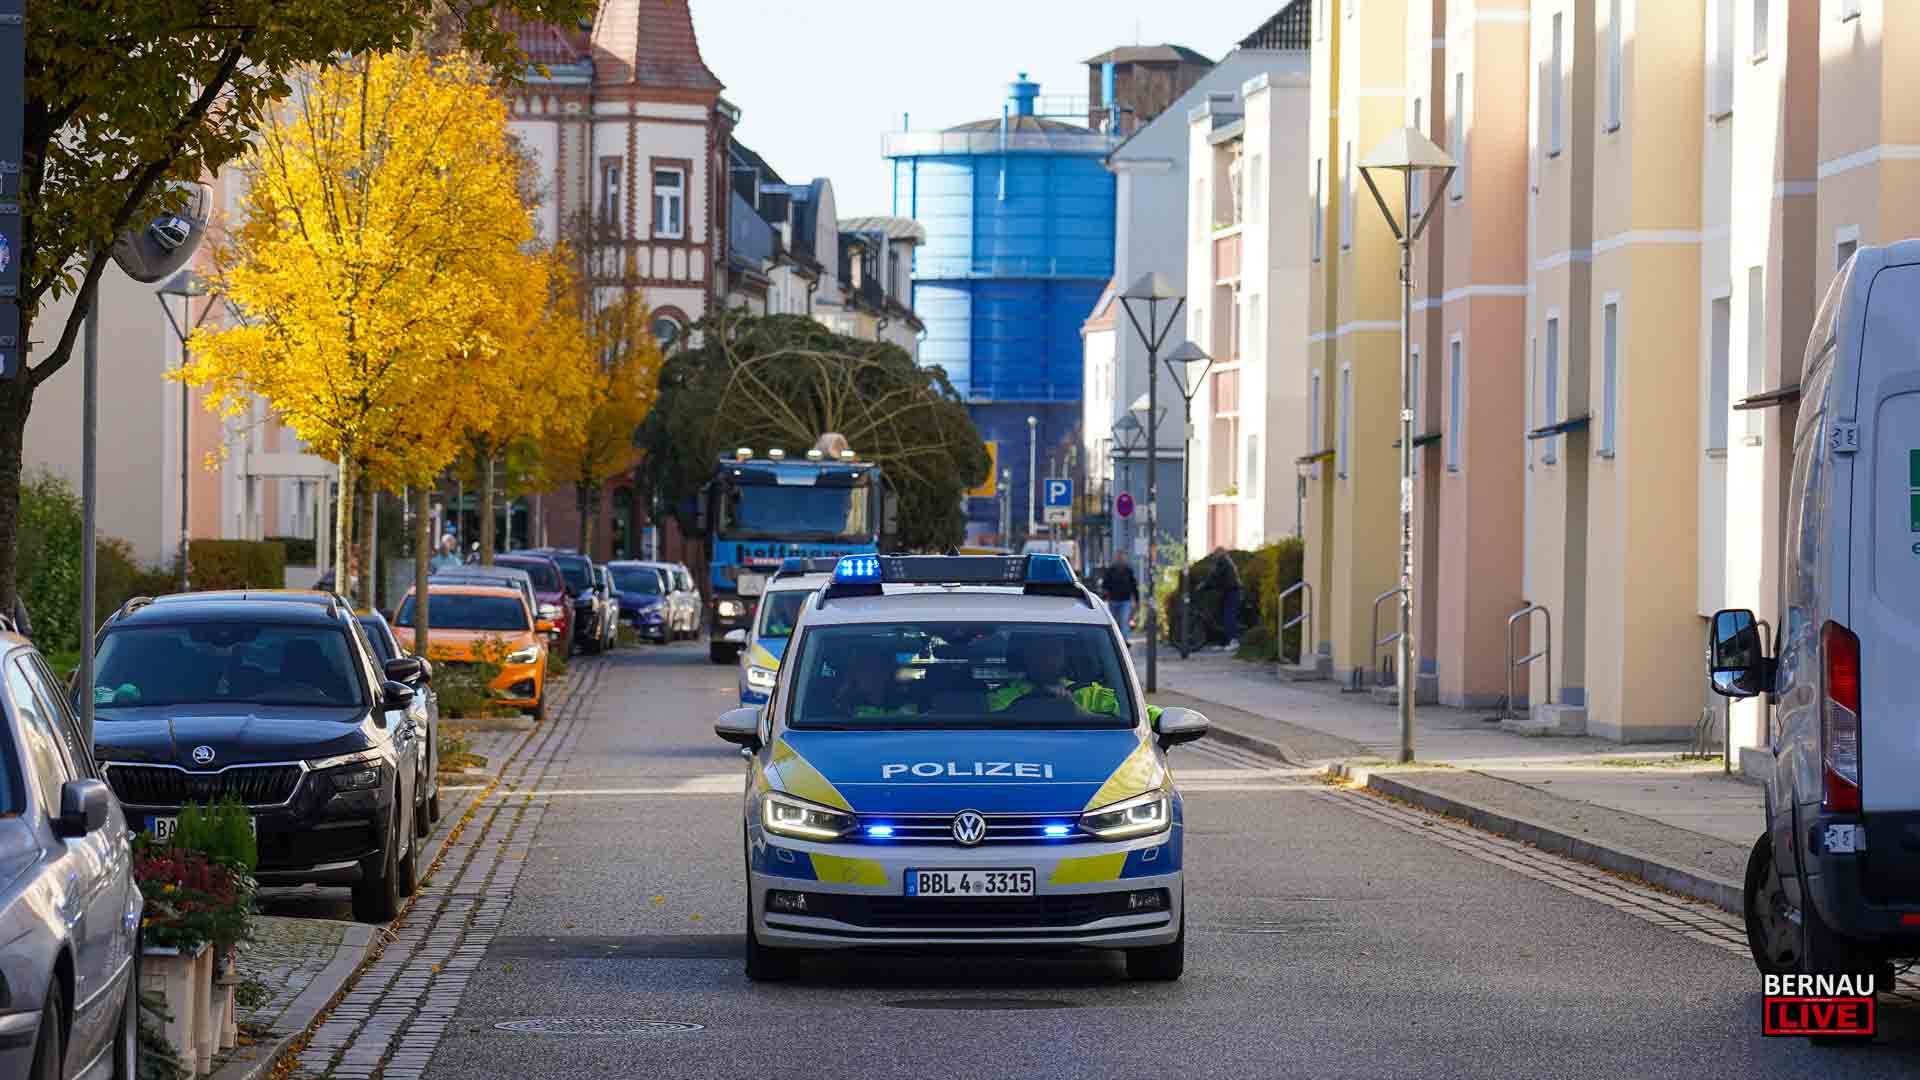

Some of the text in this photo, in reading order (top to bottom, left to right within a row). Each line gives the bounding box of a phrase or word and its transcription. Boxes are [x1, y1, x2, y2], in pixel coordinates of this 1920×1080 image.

[1050, 481, 1067, 504] P
[881, 762, 1055, 779] POLIZEI
[156, 819, 178, 838] BA
[919, 872, 1032, 894] BBL 4 3315
